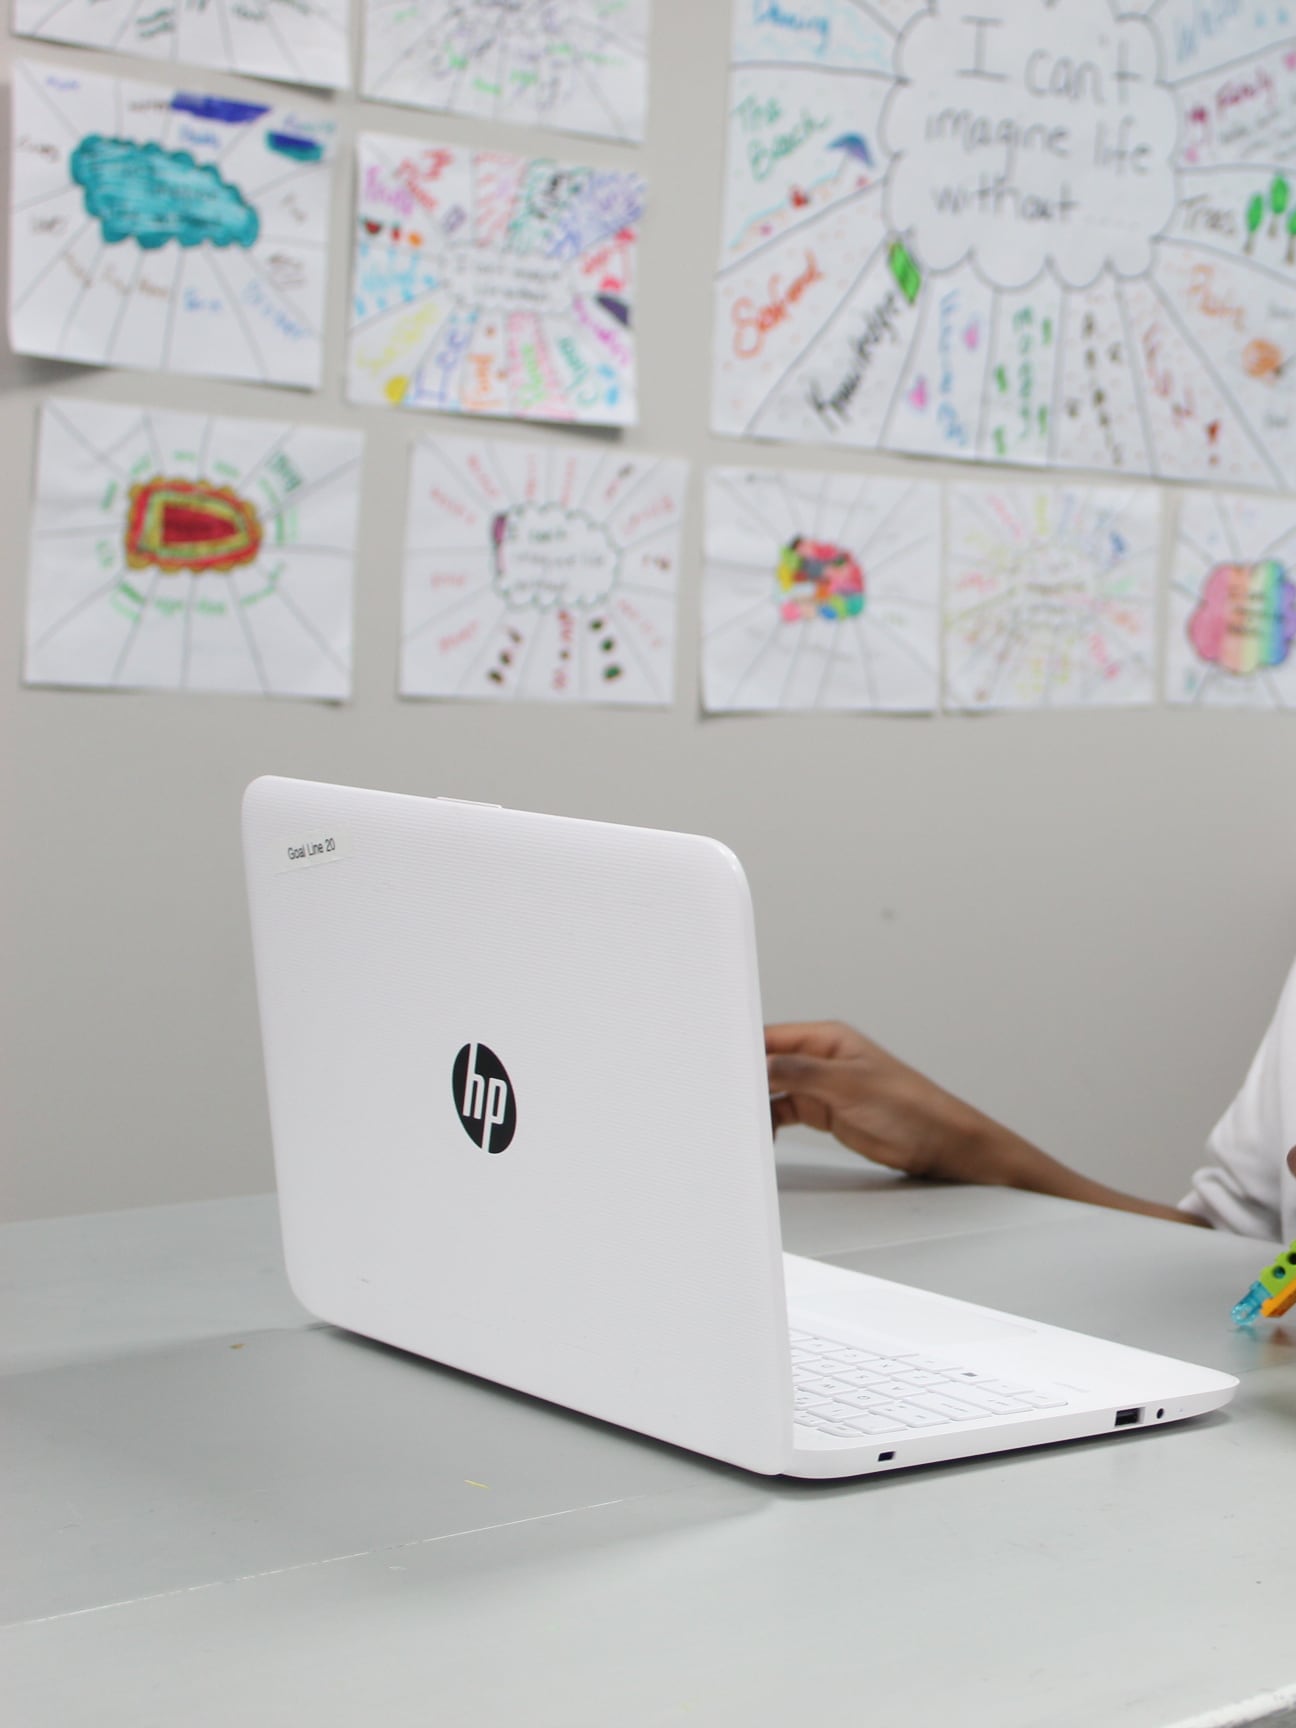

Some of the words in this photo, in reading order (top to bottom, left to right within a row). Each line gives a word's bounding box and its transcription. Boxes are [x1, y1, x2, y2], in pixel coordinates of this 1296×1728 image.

[954, 13, 1010, 82] I
[288, 844, 306, 860] Goal
[306, 842, 324, 856] Line
[325, 837, 336, 852] 20
[462, 1043, 508, 1153] hp
